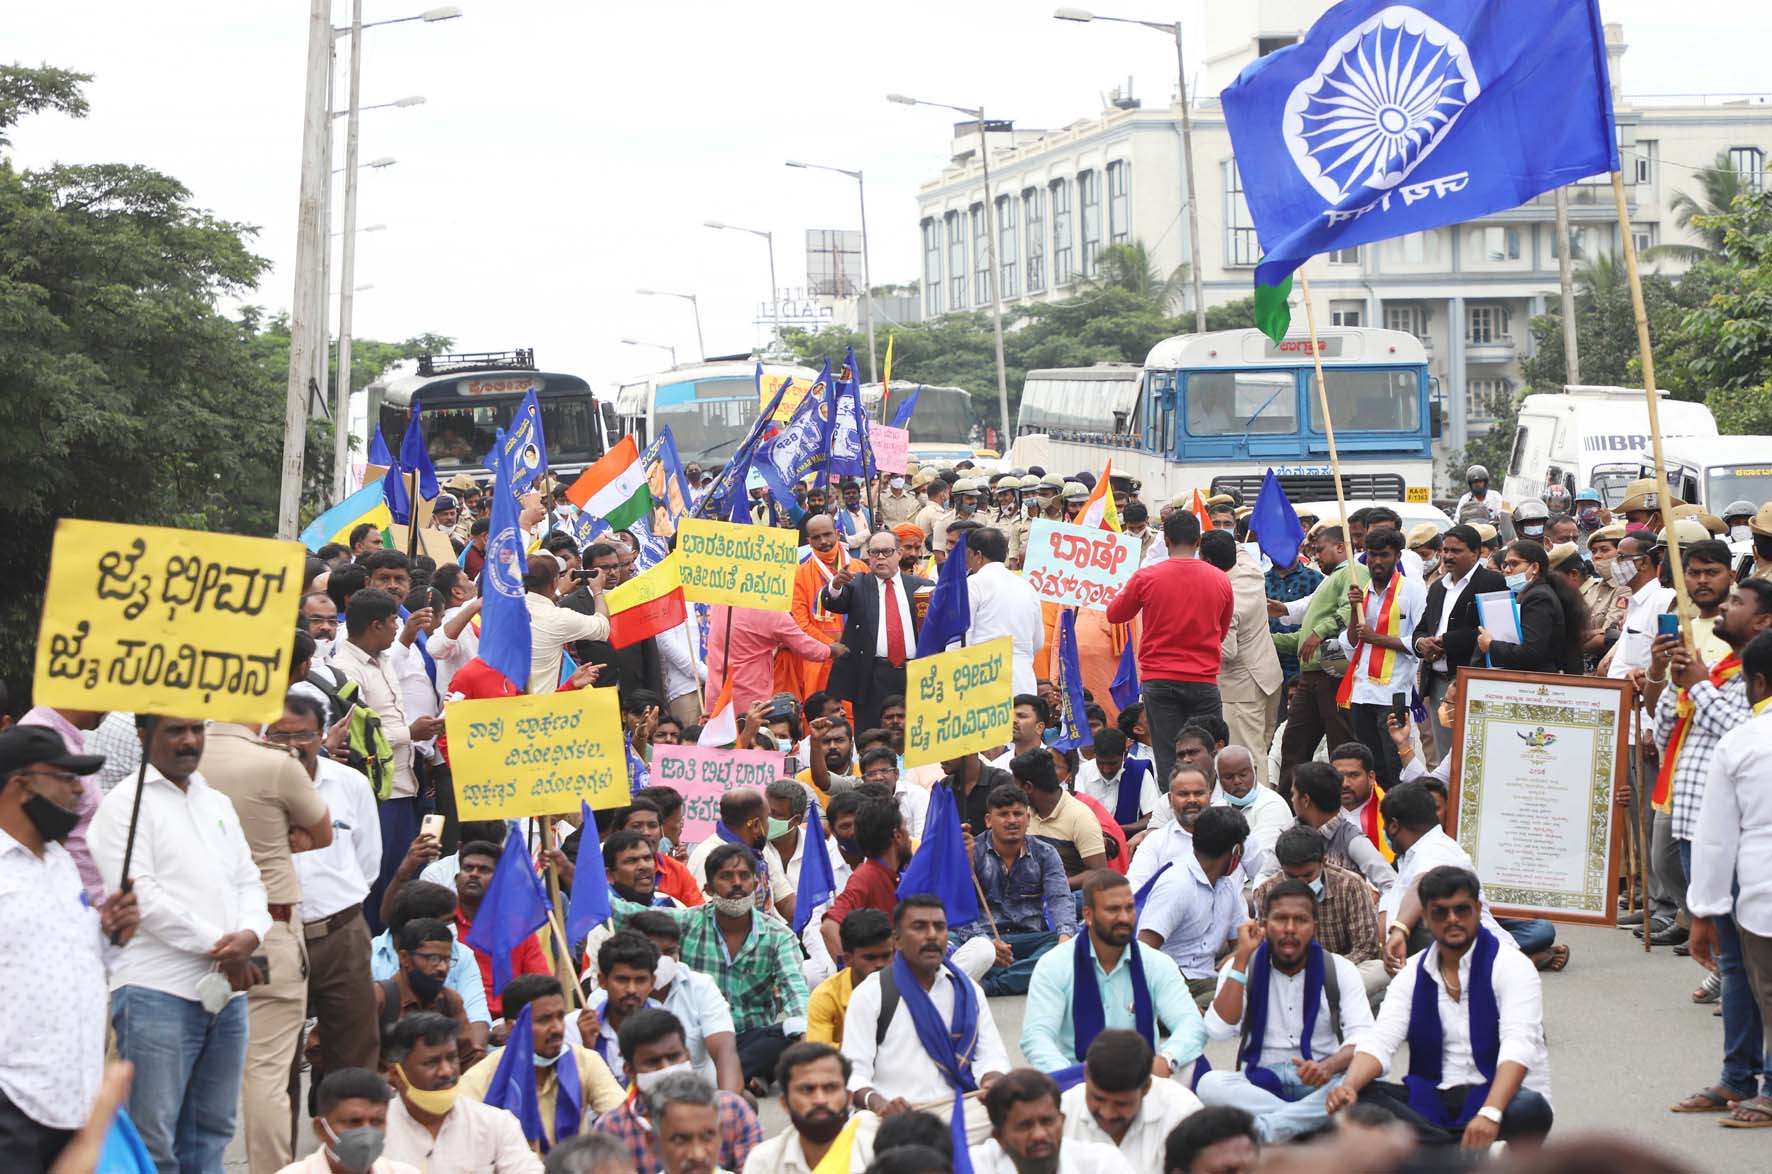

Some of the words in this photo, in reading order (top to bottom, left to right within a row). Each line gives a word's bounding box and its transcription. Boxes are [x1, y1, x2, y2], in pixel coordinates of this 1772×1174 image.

[98, 537, 152, 621] ಜೈ
[49, 620, 100, 690] ಜೈ
[920, 664, 944, 703] ಜೈ
[911, 715, 931, 750] ಜೈ
